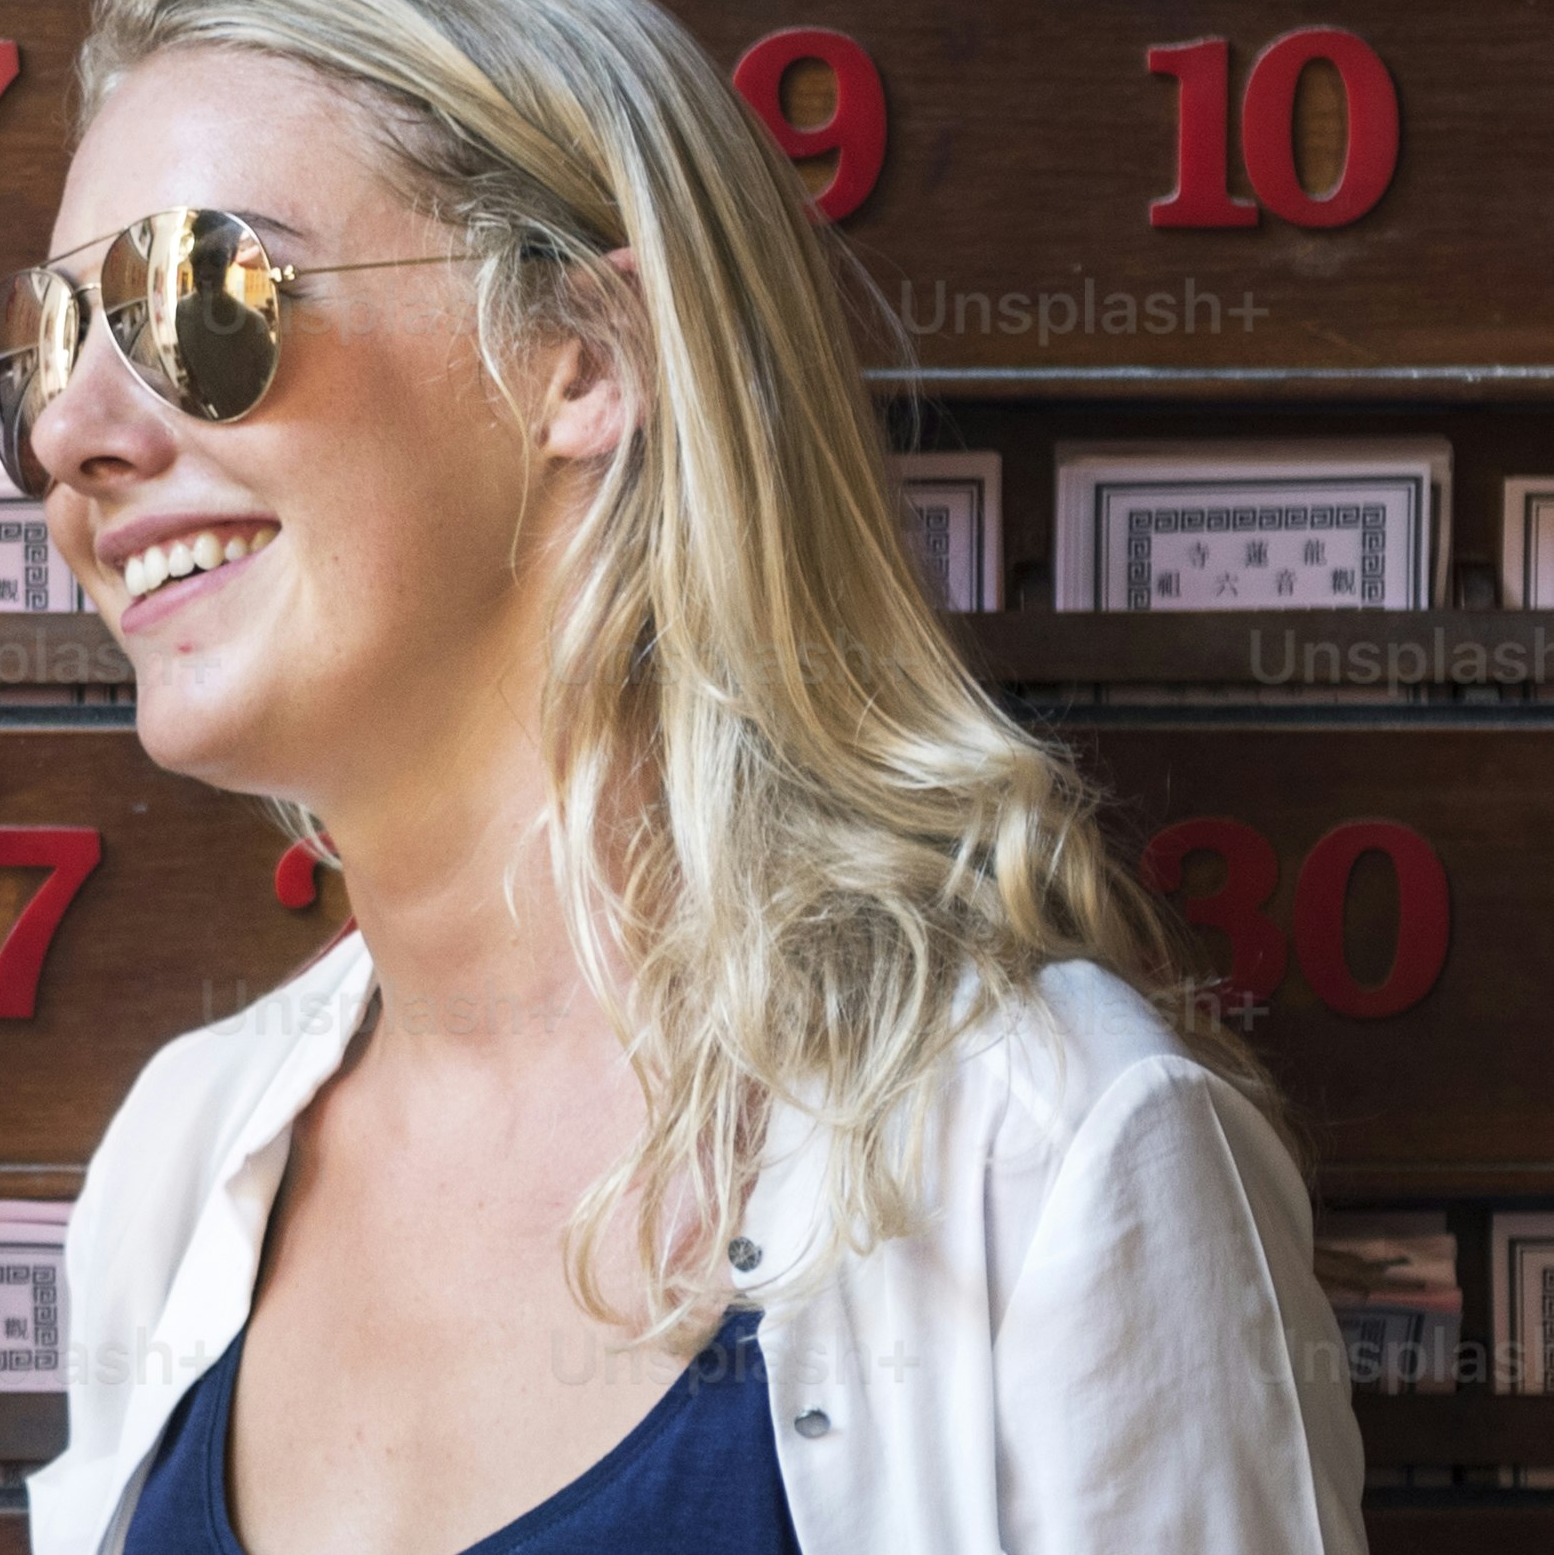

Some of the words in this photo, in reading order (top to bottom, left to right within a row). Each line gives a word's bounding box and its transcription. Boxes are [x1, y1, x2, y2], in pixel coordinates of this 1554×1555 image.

[733, 27, 887, 223] 9
[1147, 26, 1400, 227] 10
[1139, 816, 1450, 1019] 30
